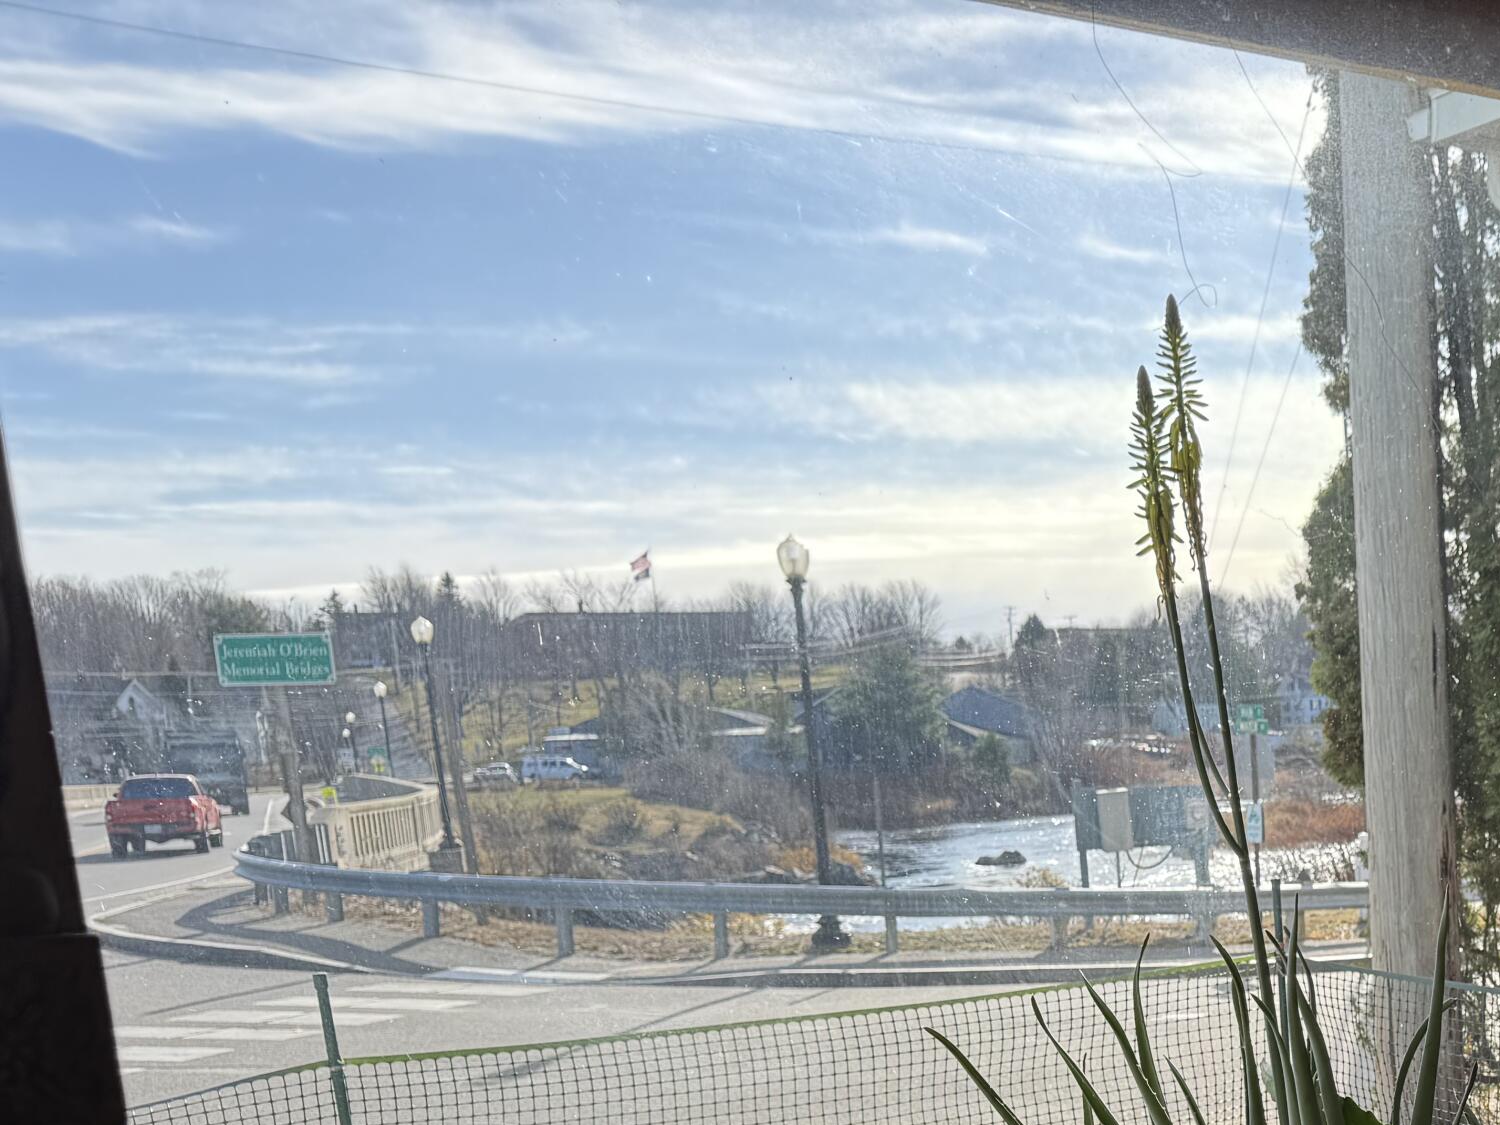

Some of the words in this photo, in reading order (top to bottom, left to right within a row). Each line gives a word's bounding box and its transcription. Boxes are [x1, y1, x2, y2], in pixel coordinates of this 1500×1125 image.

[222, 643, 276, 660] Jeremiah
[279, 642, 328, 657] O'Brien
[223, 661, 280, 677] Memorial
